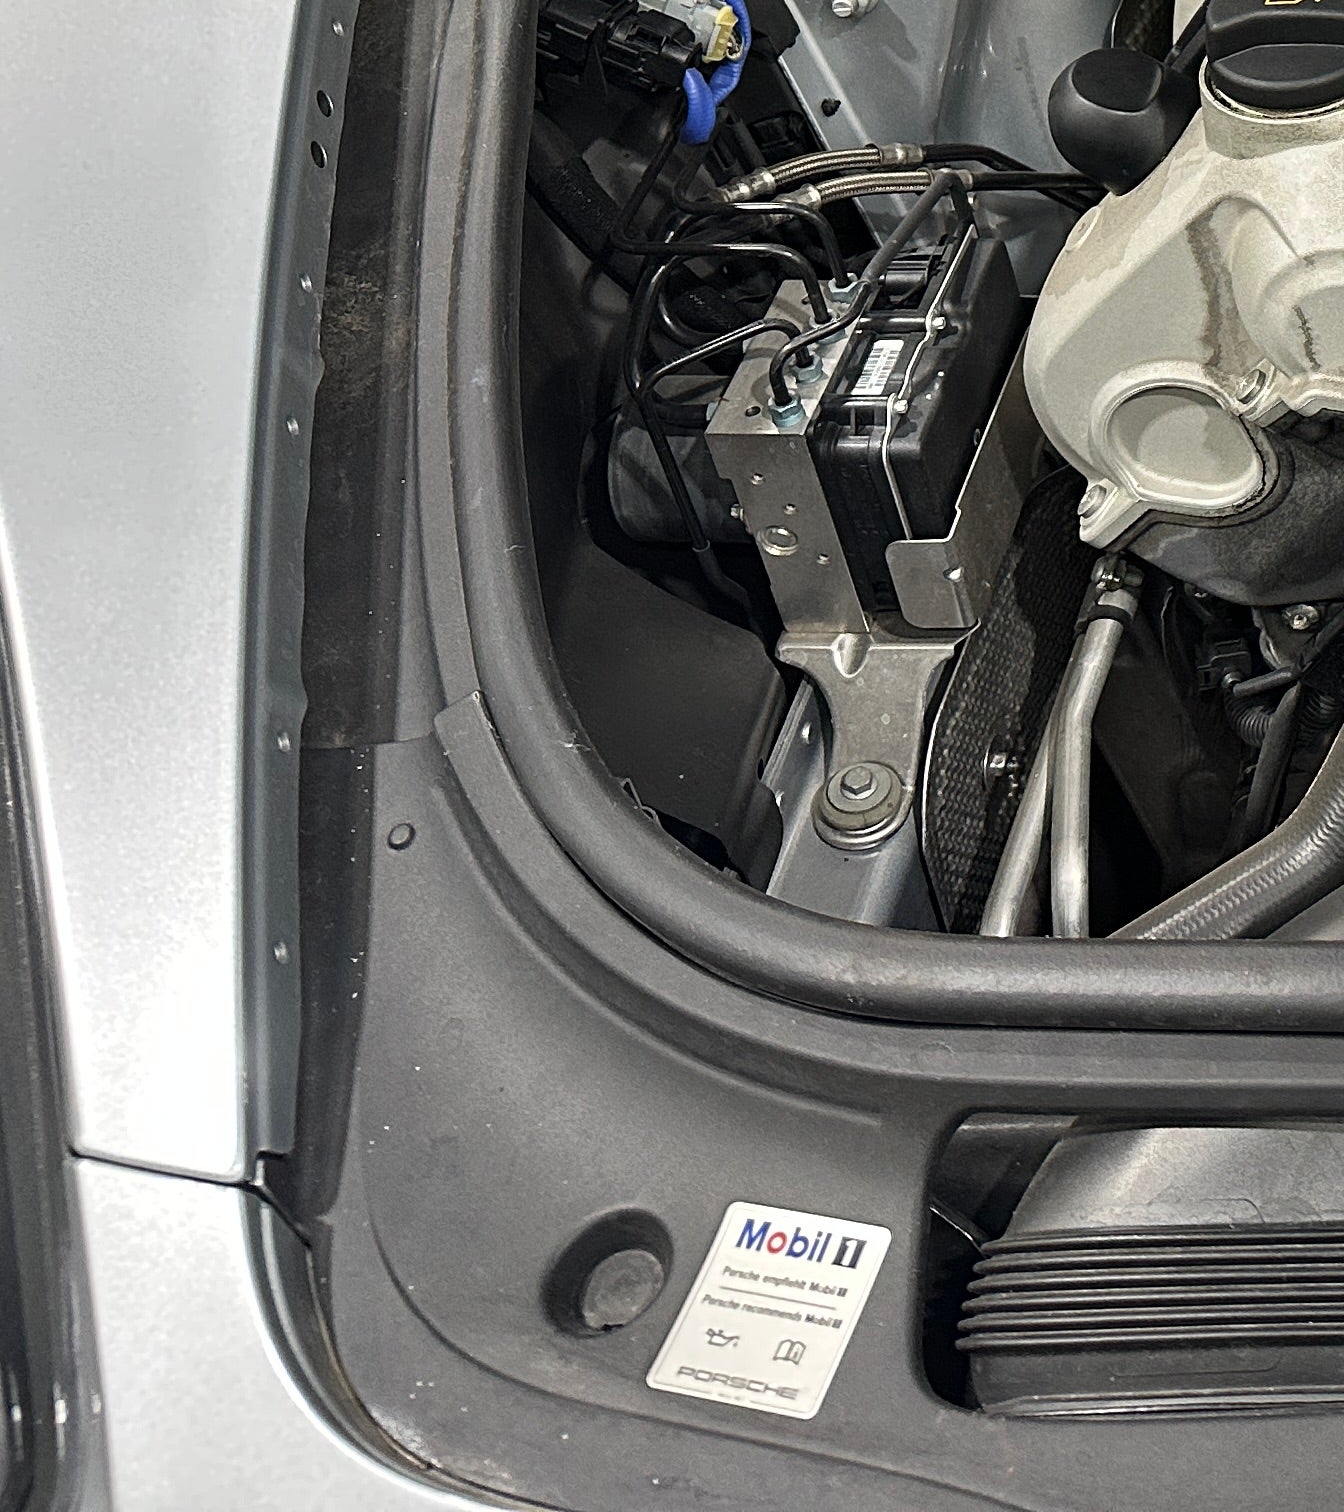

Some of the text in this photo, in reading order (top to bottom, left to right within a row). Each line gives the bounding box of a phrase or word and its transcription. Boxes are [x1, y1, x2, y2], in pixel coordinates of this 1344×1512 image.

[735, 1218, 867, 1269] Mobil 1
[722, 1265, 760, 1281] Porsche
[809, 1281, 837, 1295] Mobil
[702, 1294, 740, 1310] Porsche
[676, 1365, 800, 1400] PORSCHE
